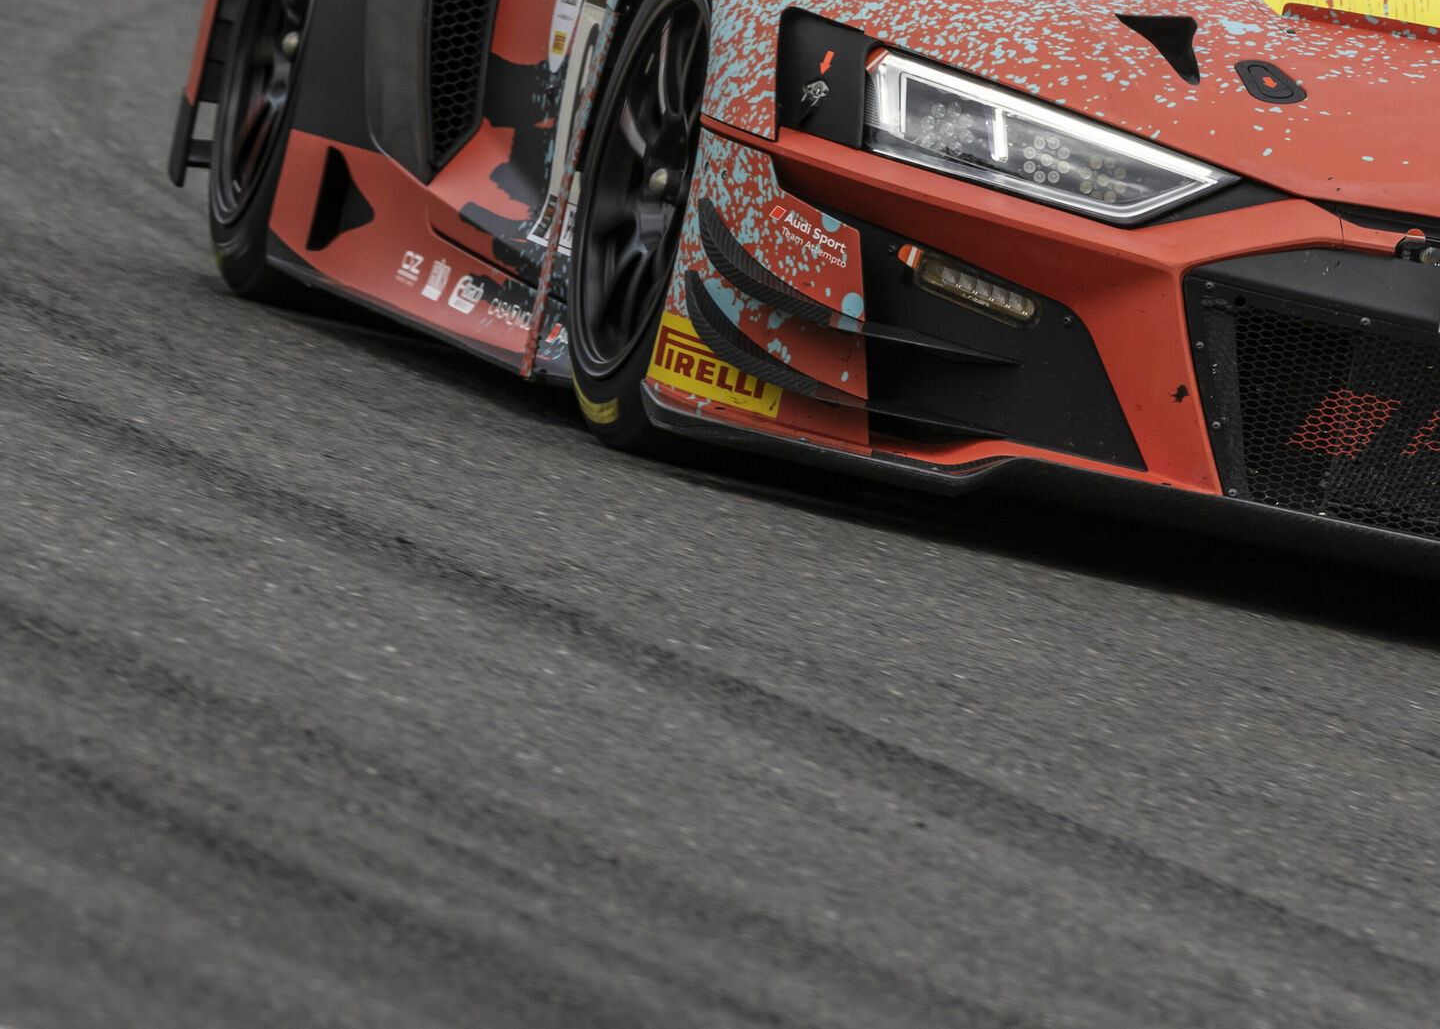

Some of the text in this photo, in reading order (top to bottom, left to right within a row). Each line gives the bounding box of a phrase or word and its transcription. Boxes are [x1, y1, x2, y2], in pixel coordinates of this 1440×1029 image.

[781, 226, 847, 269] Team Attempto
[783, 212, 847, 254] Audi Sport
[653, 324, 767, 400] PIRELLI
